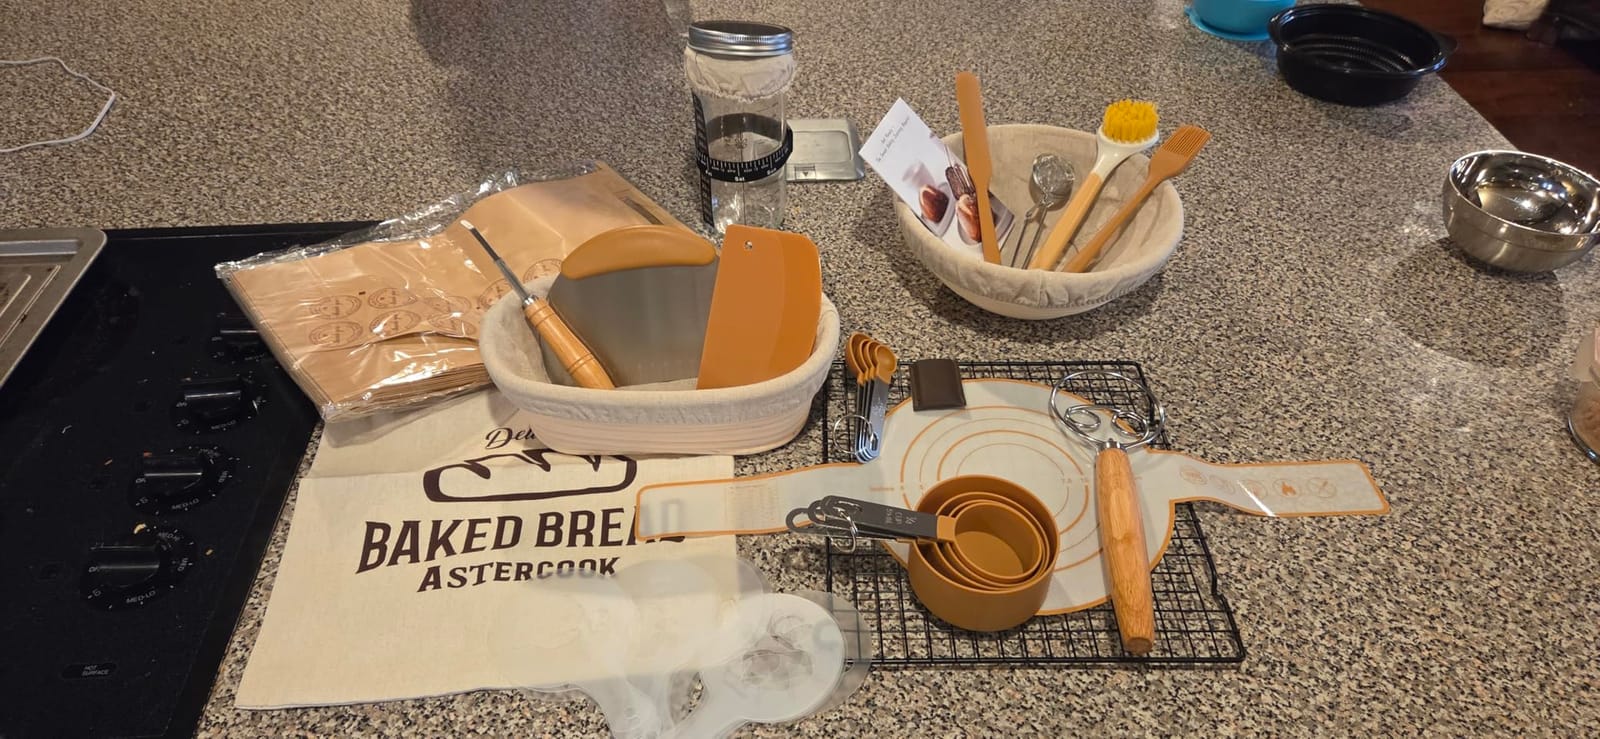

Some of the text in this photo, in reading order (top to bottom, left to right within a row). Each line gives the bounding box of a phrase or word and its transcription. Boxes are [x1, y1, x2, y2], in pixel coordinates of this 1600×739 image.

[355, 515, 523, 574] BAKED
[534, 502, 686, 548] BREA
[416, 557, 620, 592] ASTERCOOK
